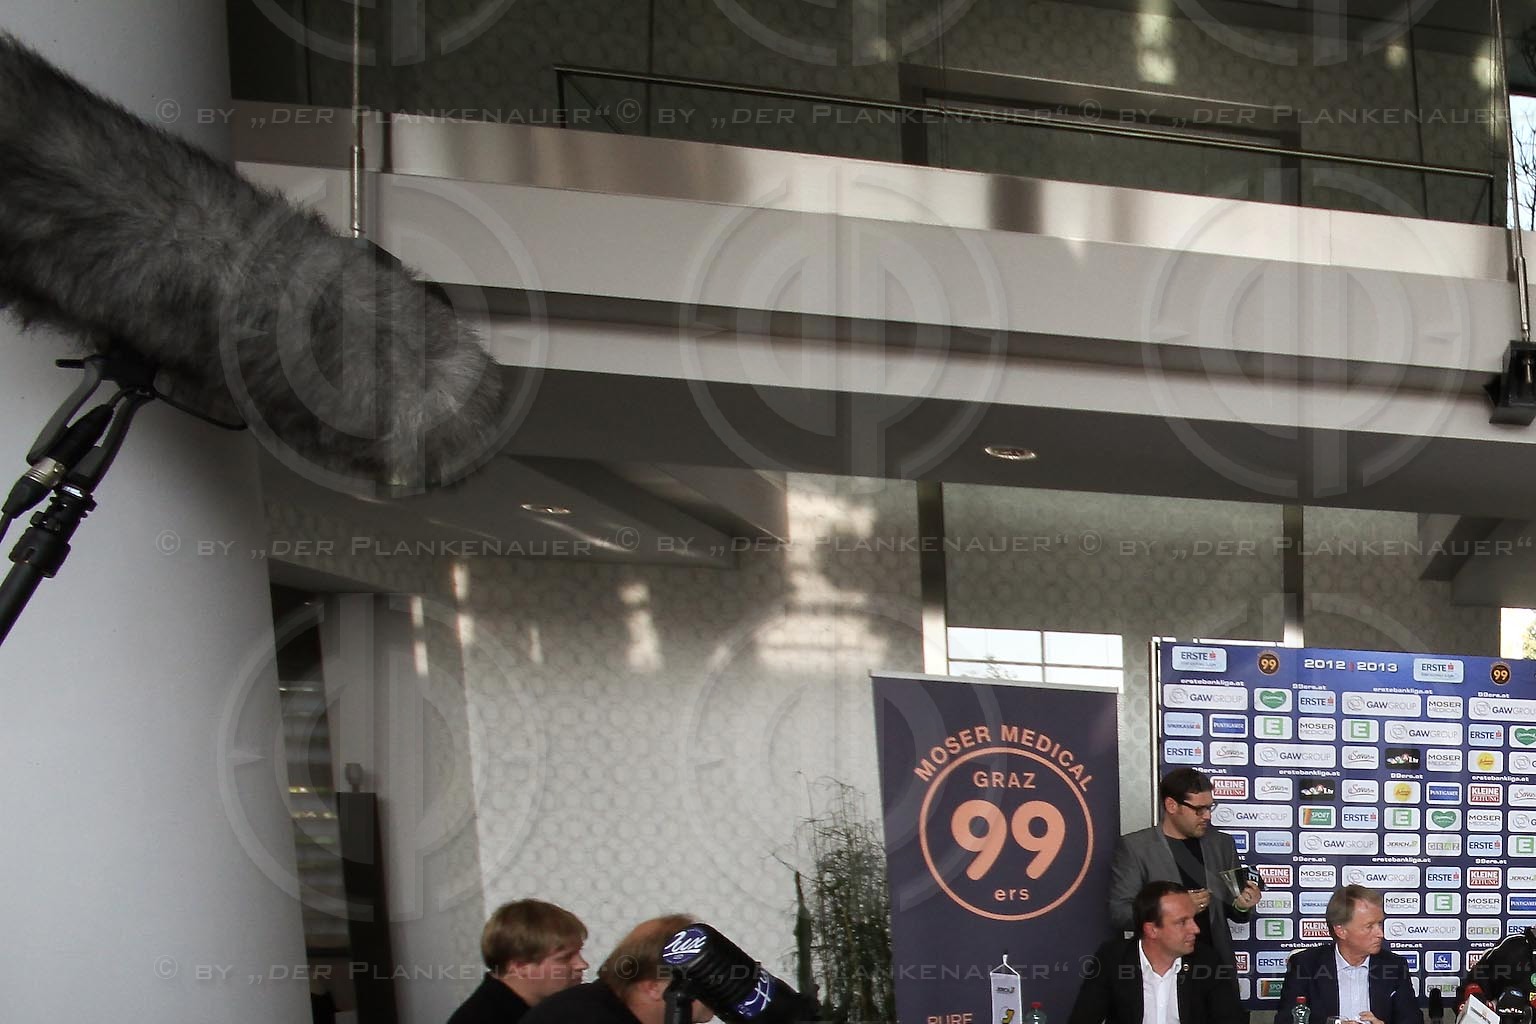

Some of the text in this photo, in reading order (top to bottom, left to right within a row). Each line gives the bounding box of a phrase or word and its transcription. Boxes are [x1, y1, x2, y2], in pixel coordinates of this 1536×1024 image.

[1181, 652, 1208, 660] ERSTE
[1261, 658, 1277, 671] 99
[1304, 659, 1398, 672] 2012 2013
[1422, 664, 1446, 672] ERSTE
[1493, 670, 1508, 680] 99
[1300, 698, 1326, 706] ERSTE
[1470, 731, 1494, 740] ERSTE
[1166, 748, 1194, 756] ERSTE
[914, 724, 1093, 792] MOSER MEDICAL
[973, 771, 1036, 788] GRAZ
[1344, 814, 1368, 822] ERSTE
[951, 799, 1066, 881] 99
[1468, 841, 1493, 850] ERSTE
[1428, 874, 1452, 882] ERSTE
[1470, 870, 1498, 878] KLEINE
[994, 888, 1030, 901] ers
